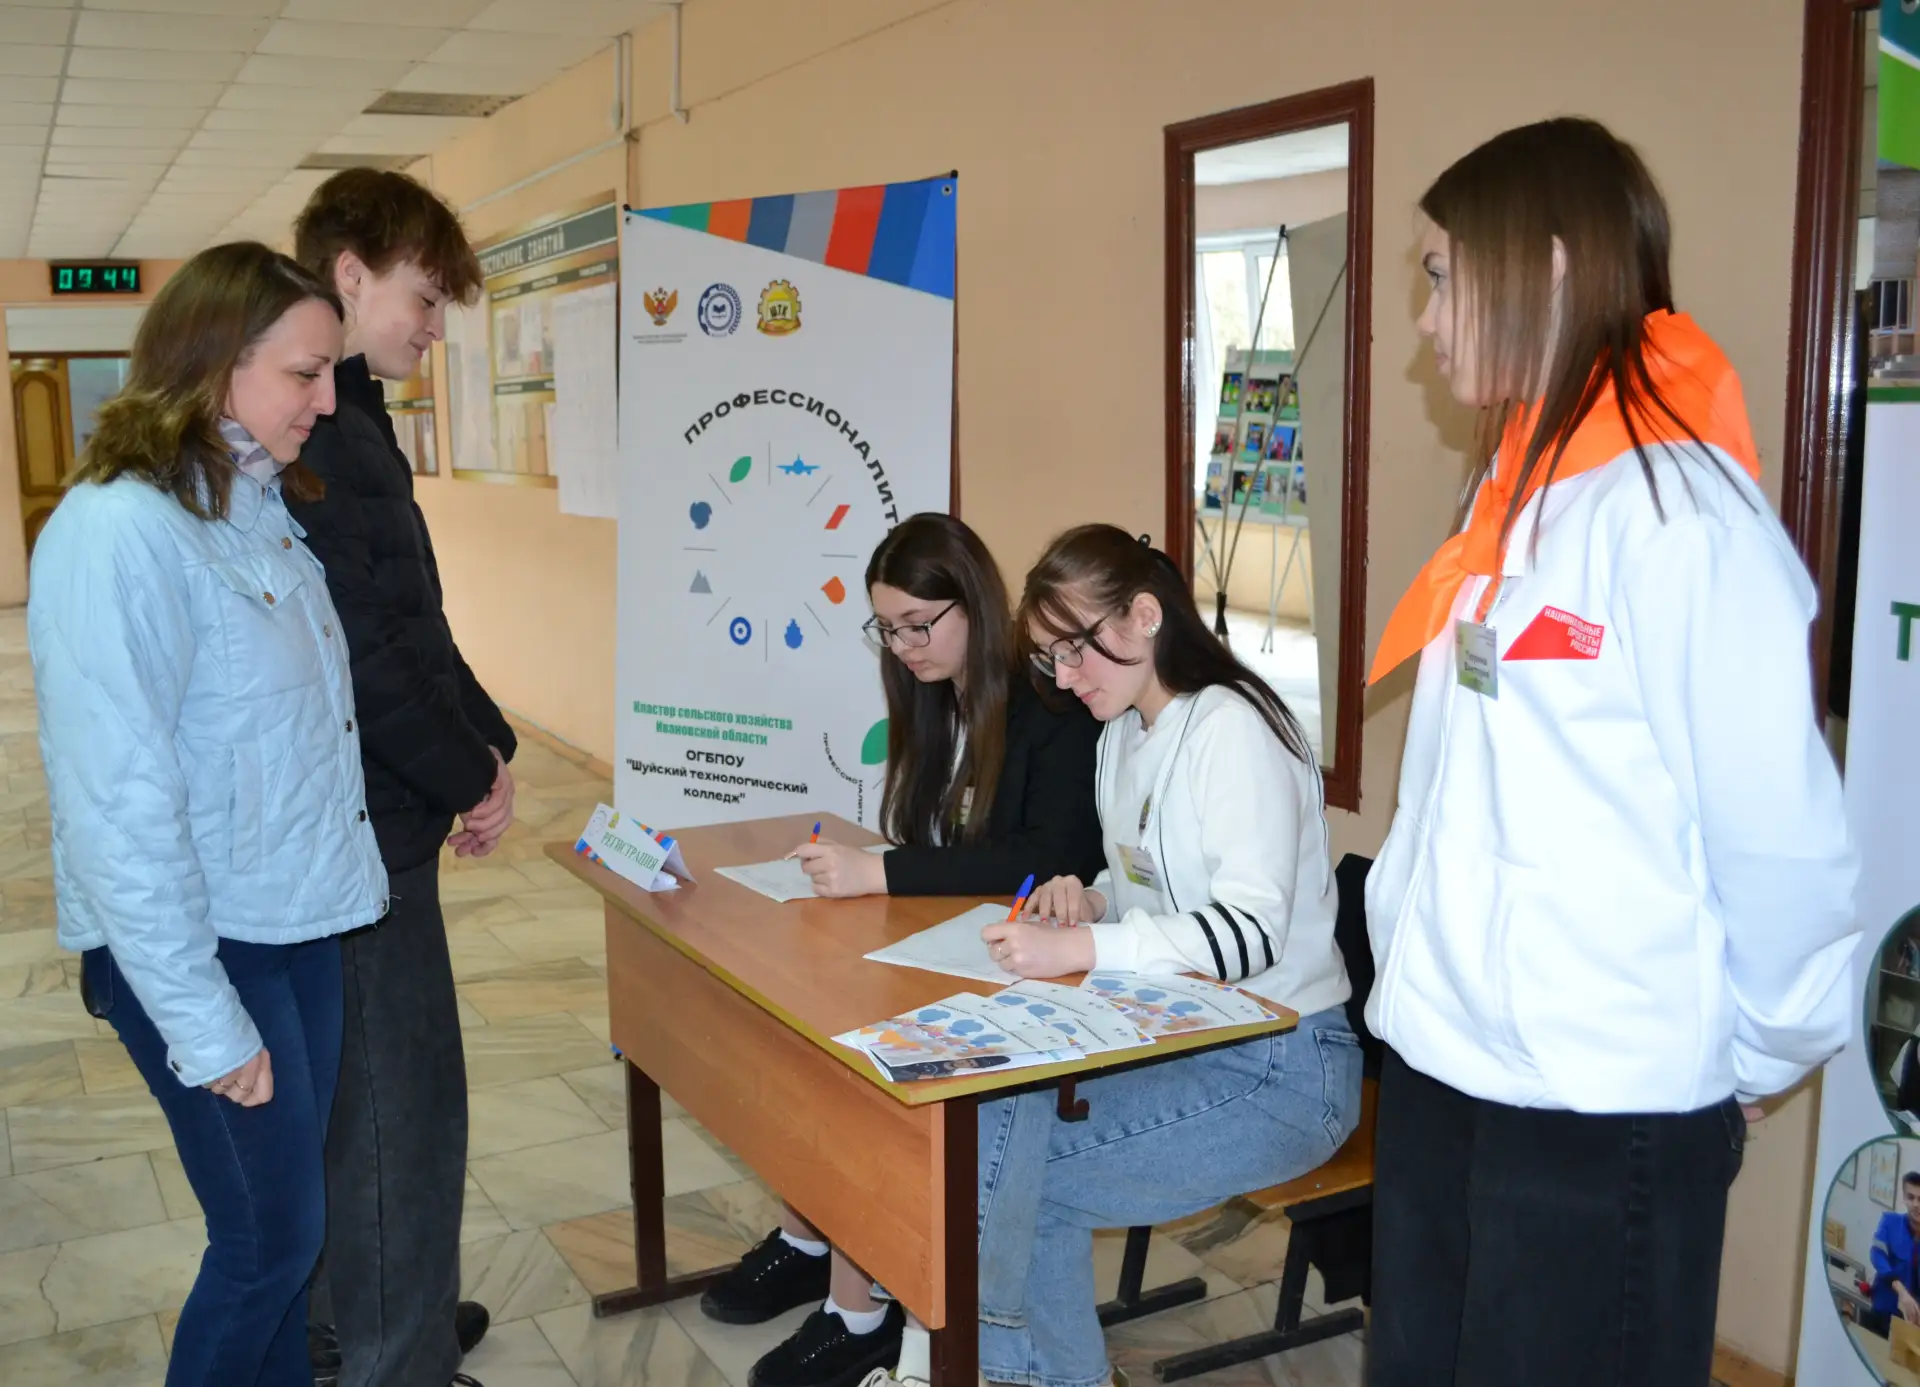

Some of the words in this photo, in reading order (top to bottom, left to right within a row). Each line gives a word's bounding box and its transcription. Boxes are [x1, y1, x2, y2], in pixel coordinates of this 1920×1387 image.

[527, 225, 565, 261] ЗАНЯТИЙ
[769, 304, 788, 318] ШТК
[1544, 607, 1602, 638] НАЦИОНАЛЬНЫЕ
[1567, 626, 1600, 648] ПРОЕКТЫ
[1569, 638, 1598, 657] РОССИИ
[633, 700, 676, 718] Кластер
[678, 707, 734, 724] сельского
[735, 713, 793, 731] хозяйства
[656, 720, 720, 740] Ивановской
[722, 728, 768, 746] области
[686, 749, 745, 768] ОГБПОУ
[626, 758, 688, 778] "Шуйский
[689, 769, 808, 795] технологический
[683, 786, 746, 804] колледж"
[601, 832, 659, 871] РЕГИСТРАЦИЯ
